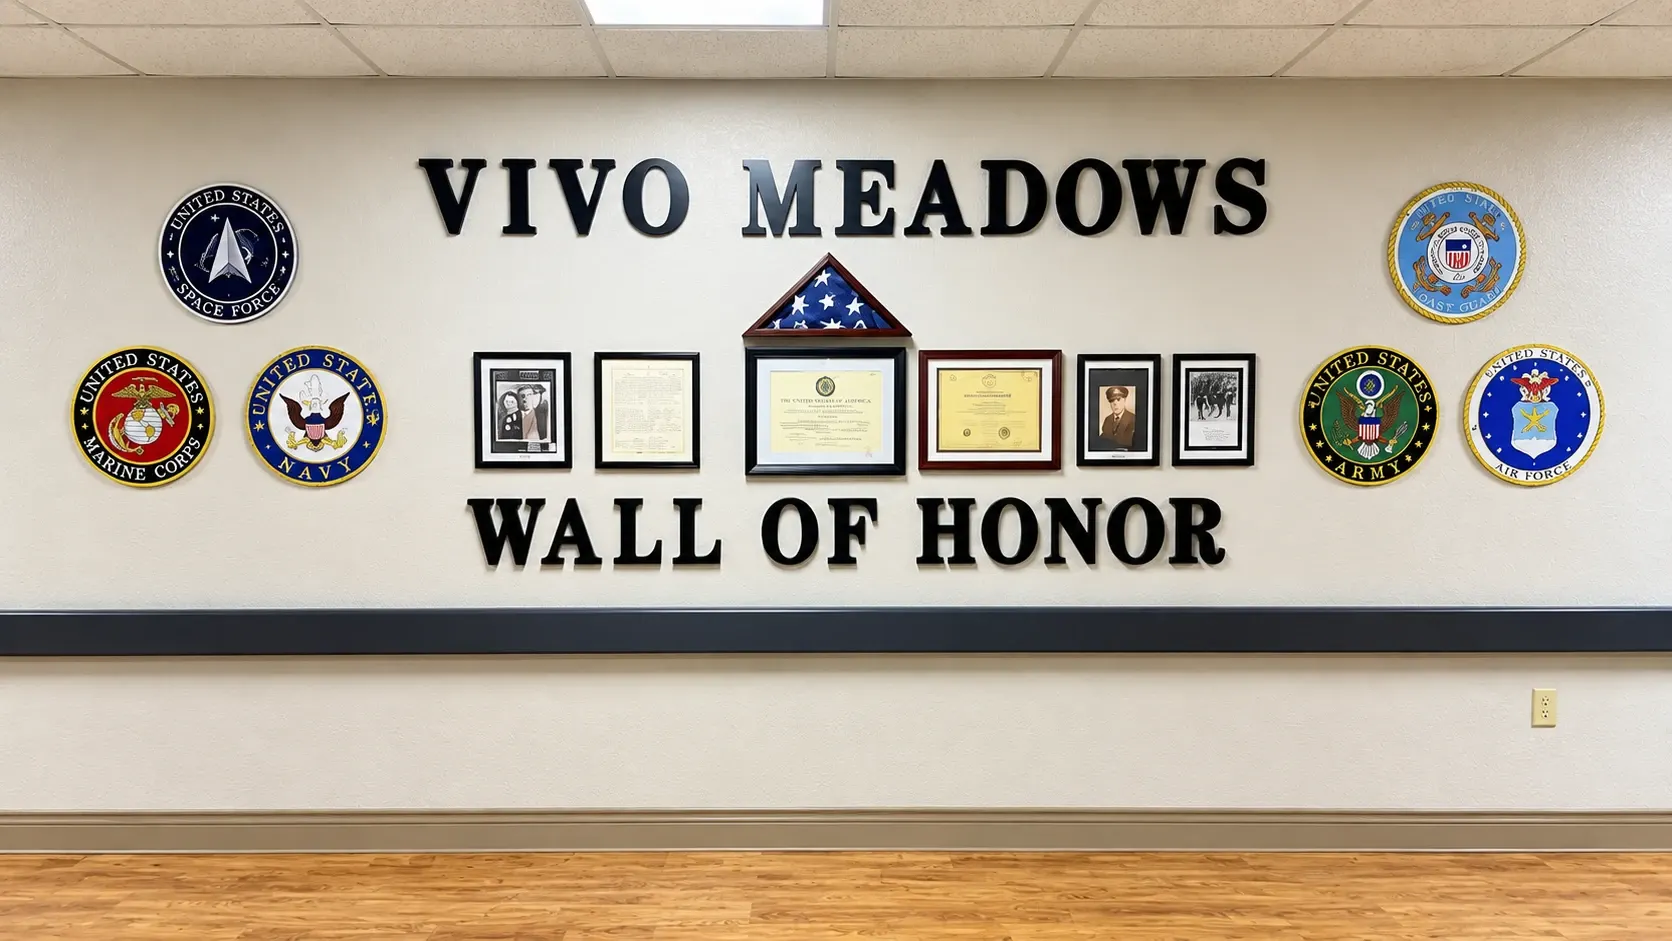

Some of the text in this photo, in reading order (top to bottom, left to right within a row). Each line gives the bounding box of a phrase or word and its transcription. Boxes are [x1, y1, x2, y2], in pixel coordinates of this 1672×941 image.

[170, 189, 285, 233] UNITED STATES
[418, 158, 1268, 237] VIVO MEADOWS
[176, 283, 281, 317] SPACE FORCE
[80, 352, 204, 404] UNITED STATES
[252, 353, 310, 415] UNITED
[1309, 351, 1432, 406] UNITED STATES
[1539, 349, 1587, 379] STATES
[83, 436, 201, 481] MARINE CORPS
[278, 456, 352, 480] NAVY
[1335, 460, 1401, 480] ARMY
[1495, 461, 1572, 481] AIR FORCE
[467, 497, 1226, 566] WALL OF HONOR
